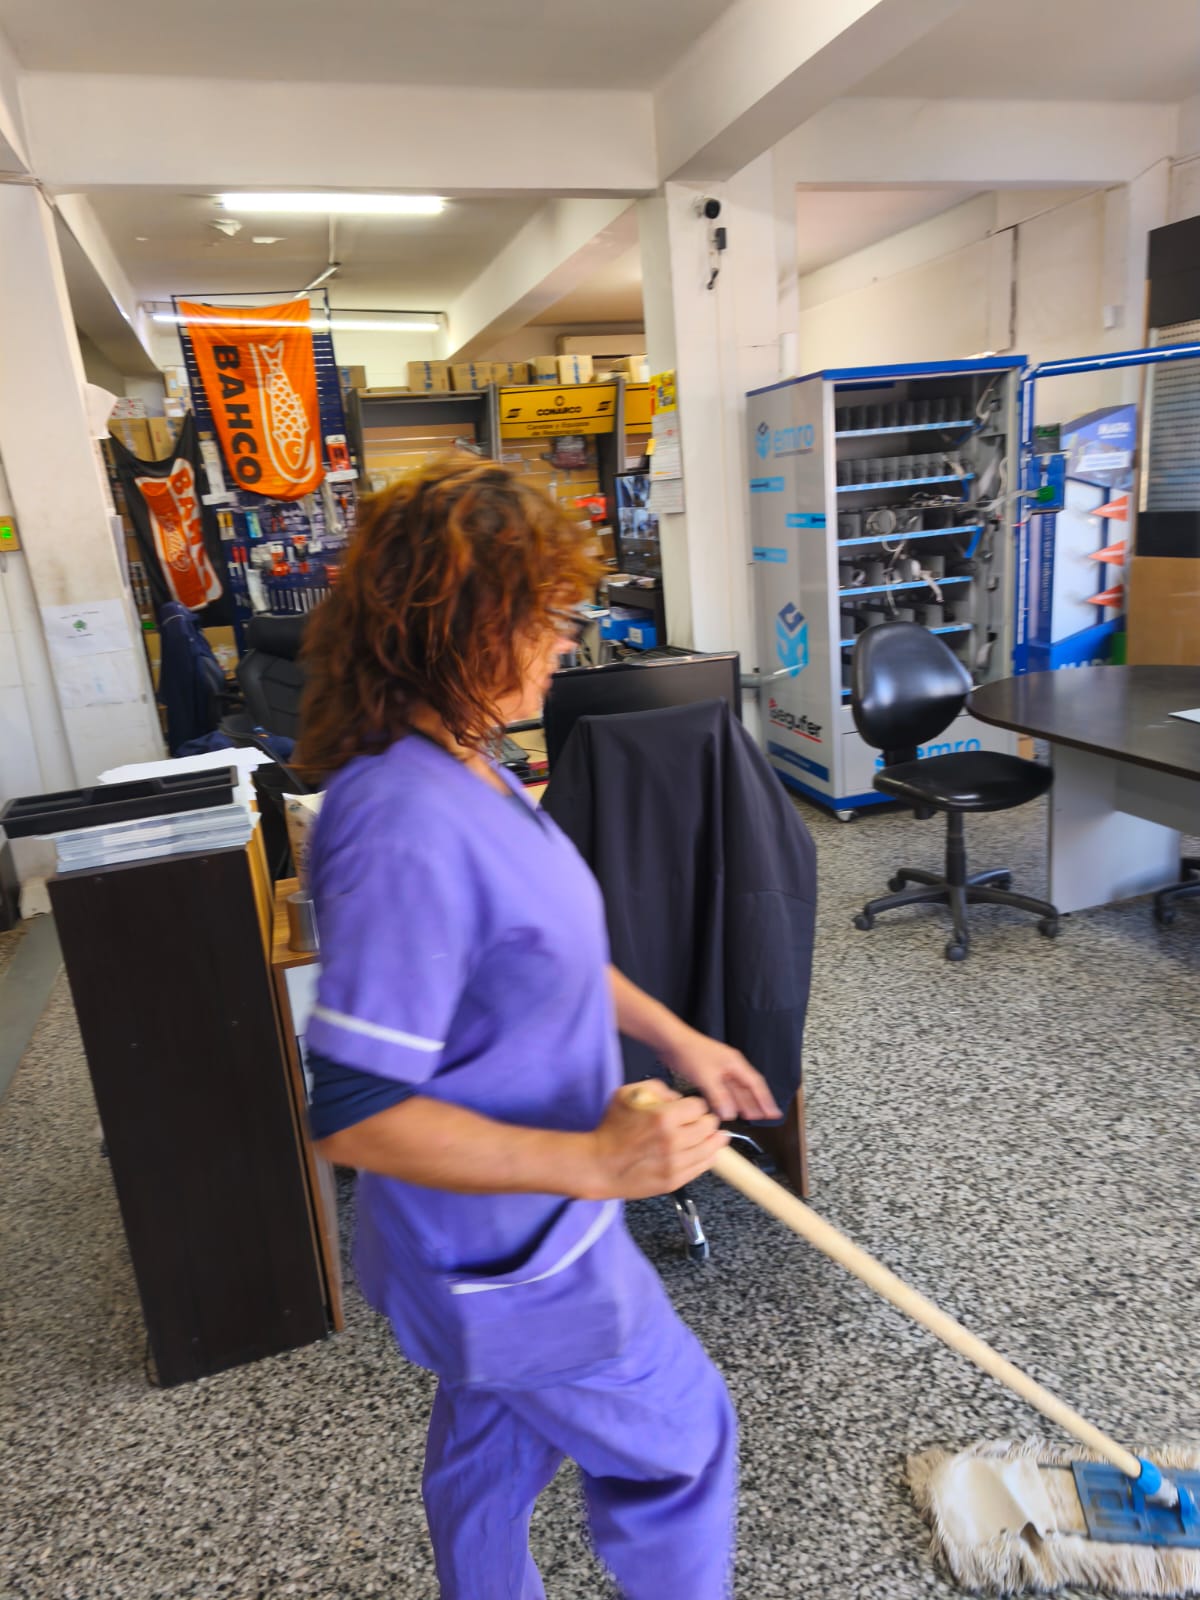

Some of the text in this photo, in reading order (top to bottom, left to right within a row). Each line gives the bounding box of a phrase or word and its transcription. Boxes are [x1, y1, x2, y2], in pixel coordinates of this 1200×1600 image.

[212, 345, 262, 484] BAHCO
[536, 406, 582, 416] CONARCO
[774, 424, 814, 451] emro
